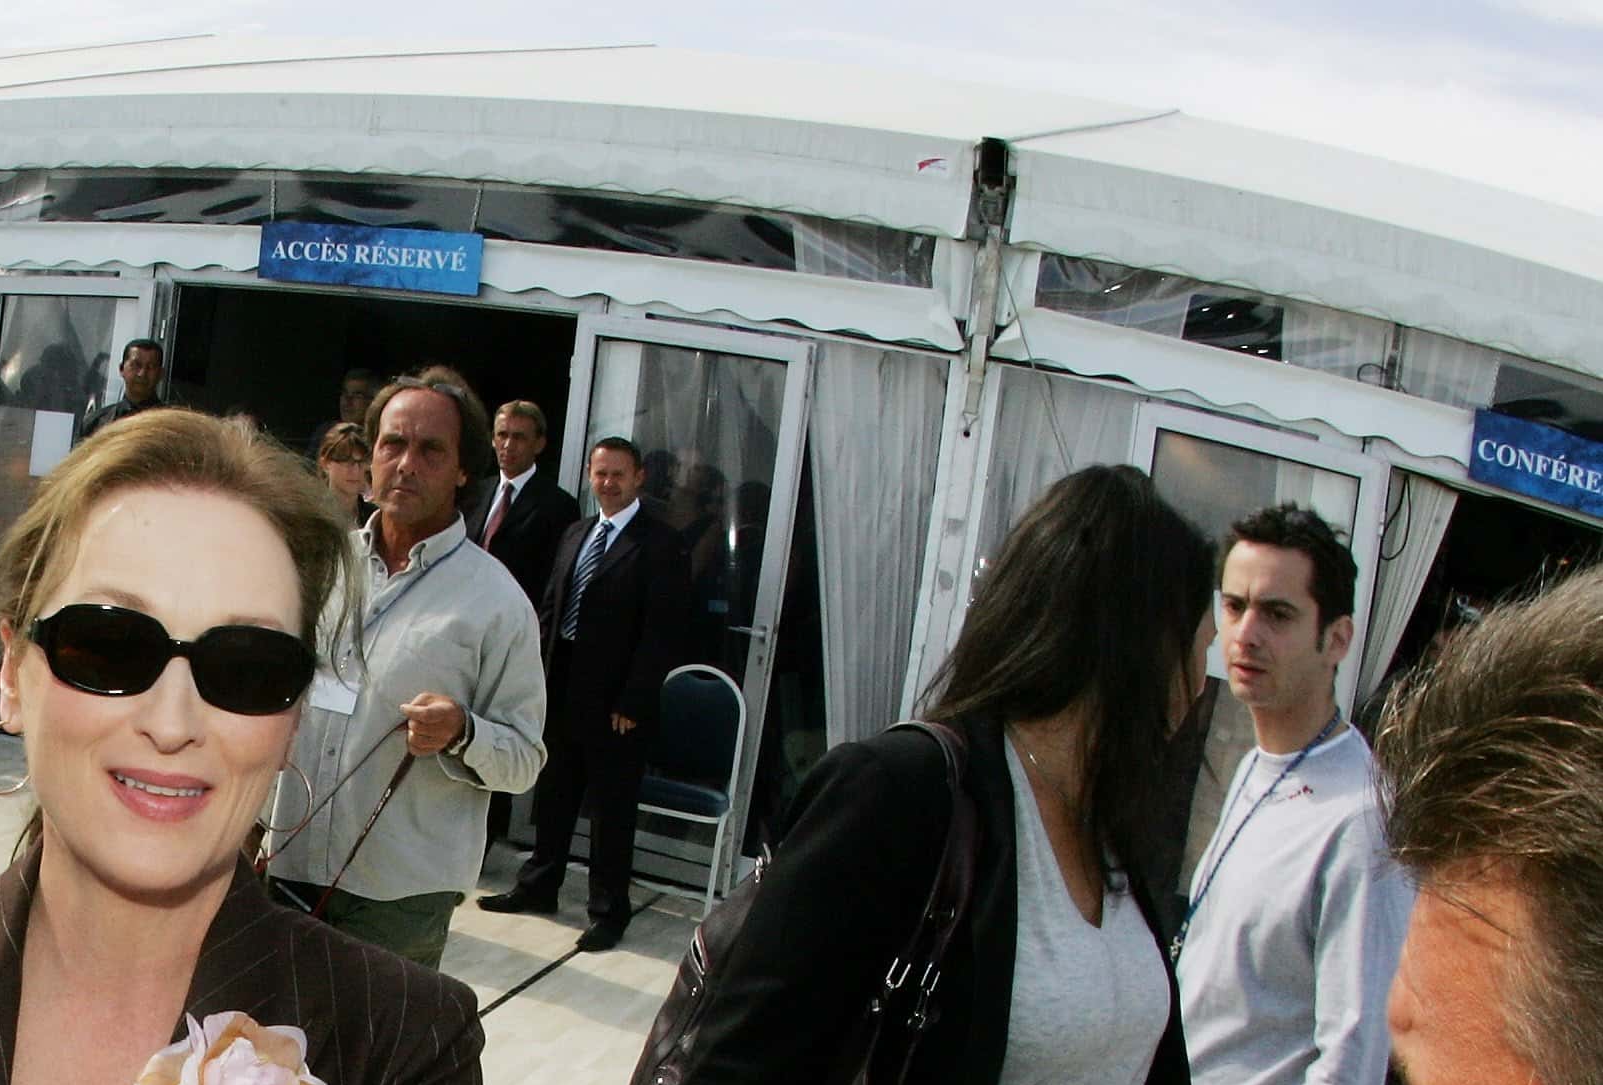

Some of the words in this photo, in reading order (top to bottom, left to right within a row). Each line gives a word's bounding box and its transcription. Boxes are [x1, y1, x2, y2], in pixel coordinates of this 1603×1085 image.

[271, 236, 348, 262] ACCÈS
[354, 240, 468, 272] RÉSERVÉ
[1477, 439, 1603, 495] CONFÉRE
